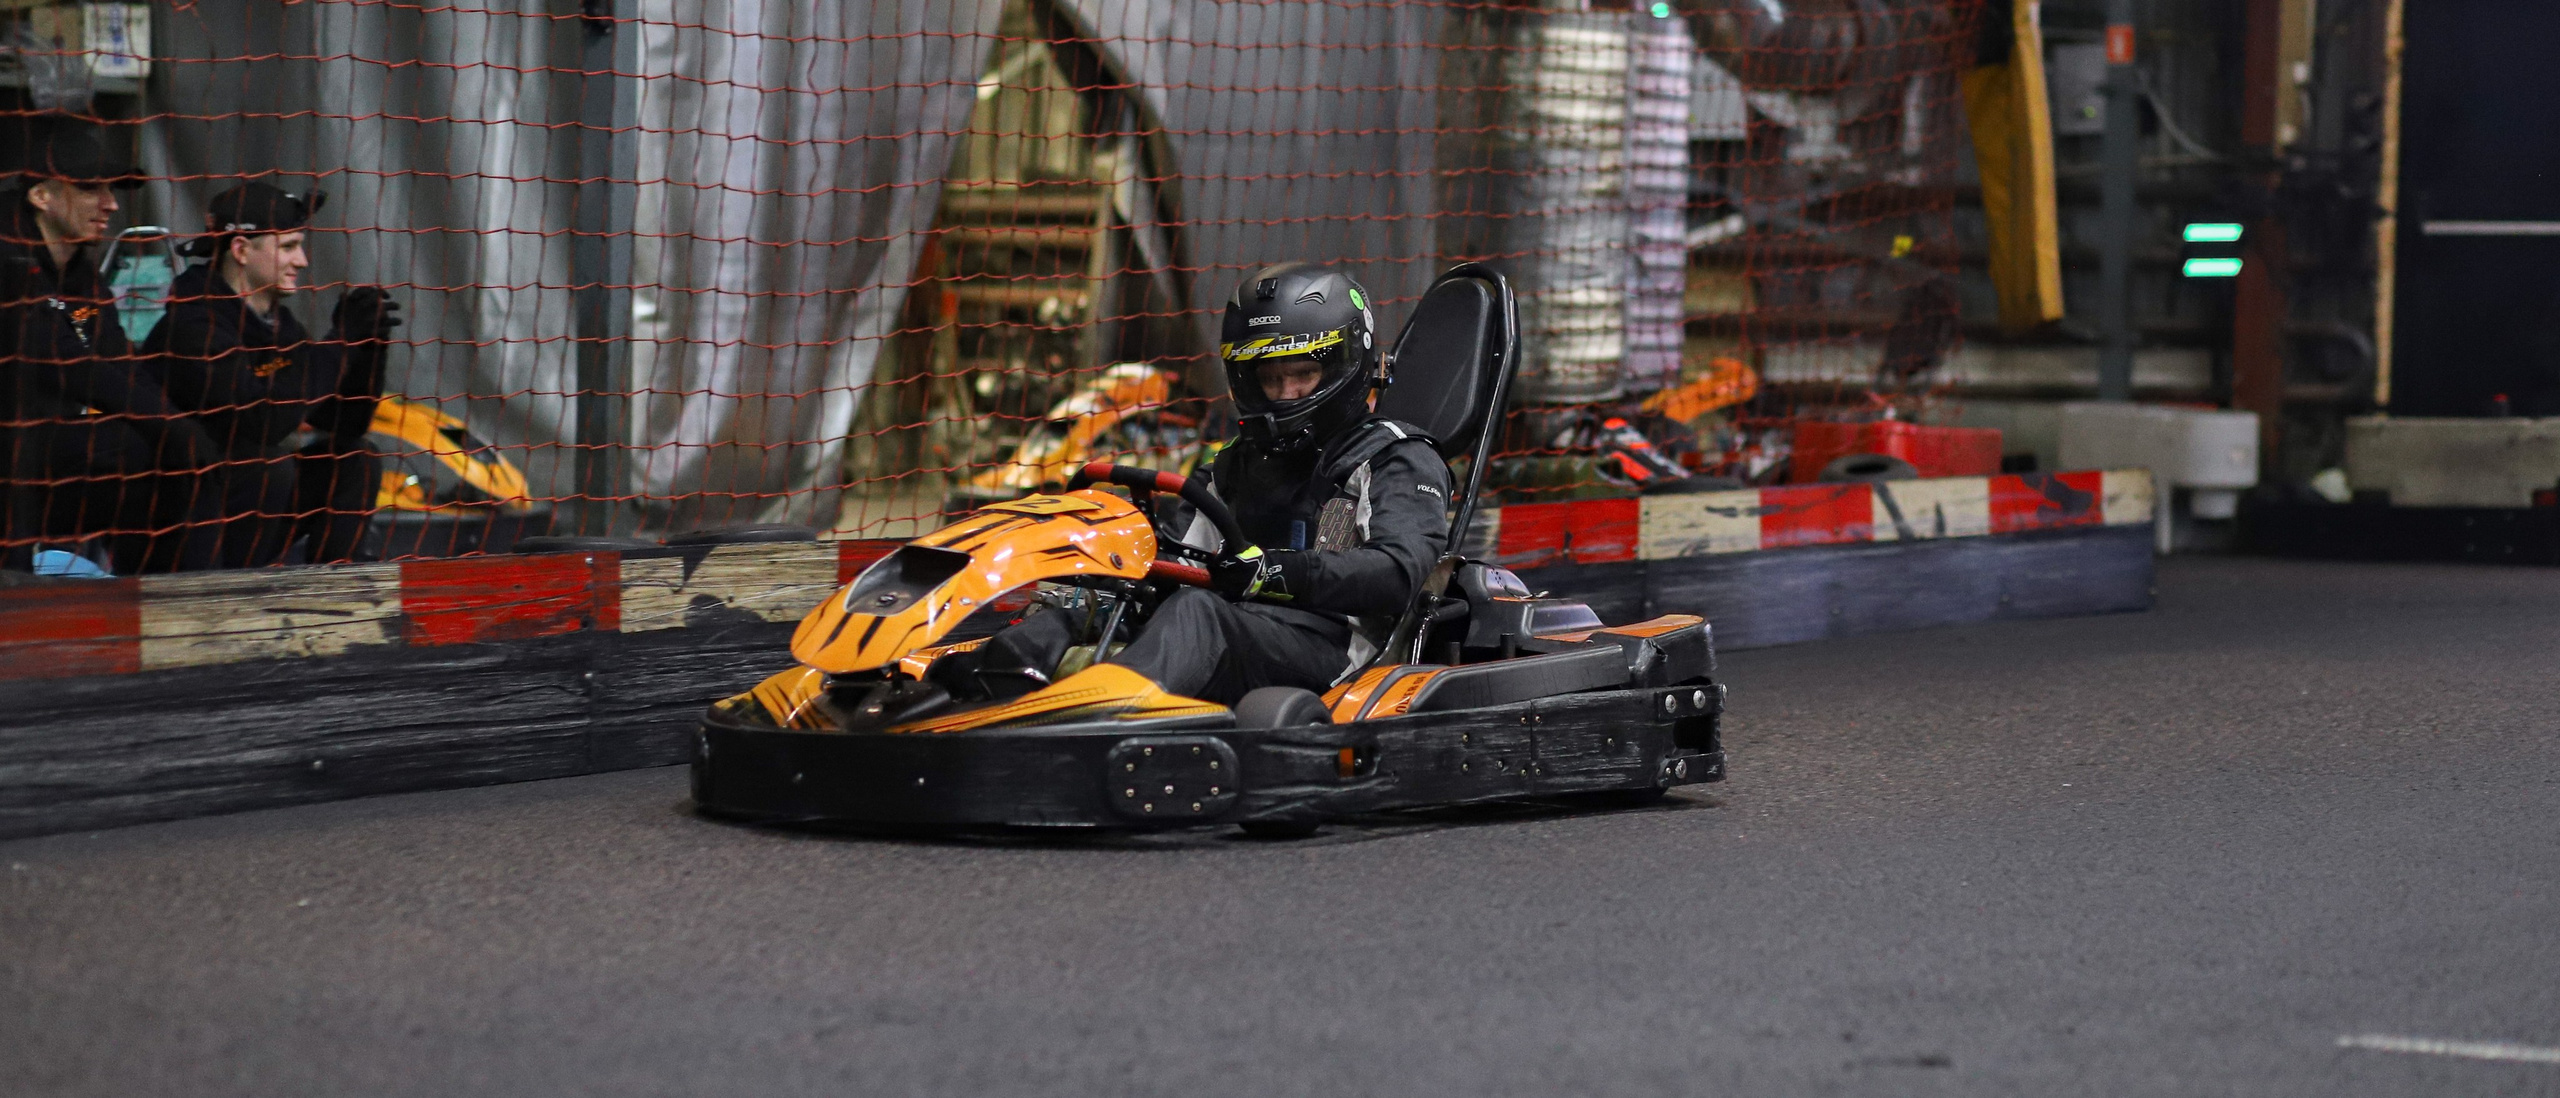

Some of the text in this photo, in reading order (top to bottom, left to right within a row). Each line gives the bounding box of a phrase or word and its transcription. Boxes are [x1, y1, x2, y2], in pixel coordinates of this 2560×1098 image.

[1249, 315, 1281, 326] sparco
[1242, 347, 1260, 355] THE
[1261, 341, 1309, 352] FASTEST
